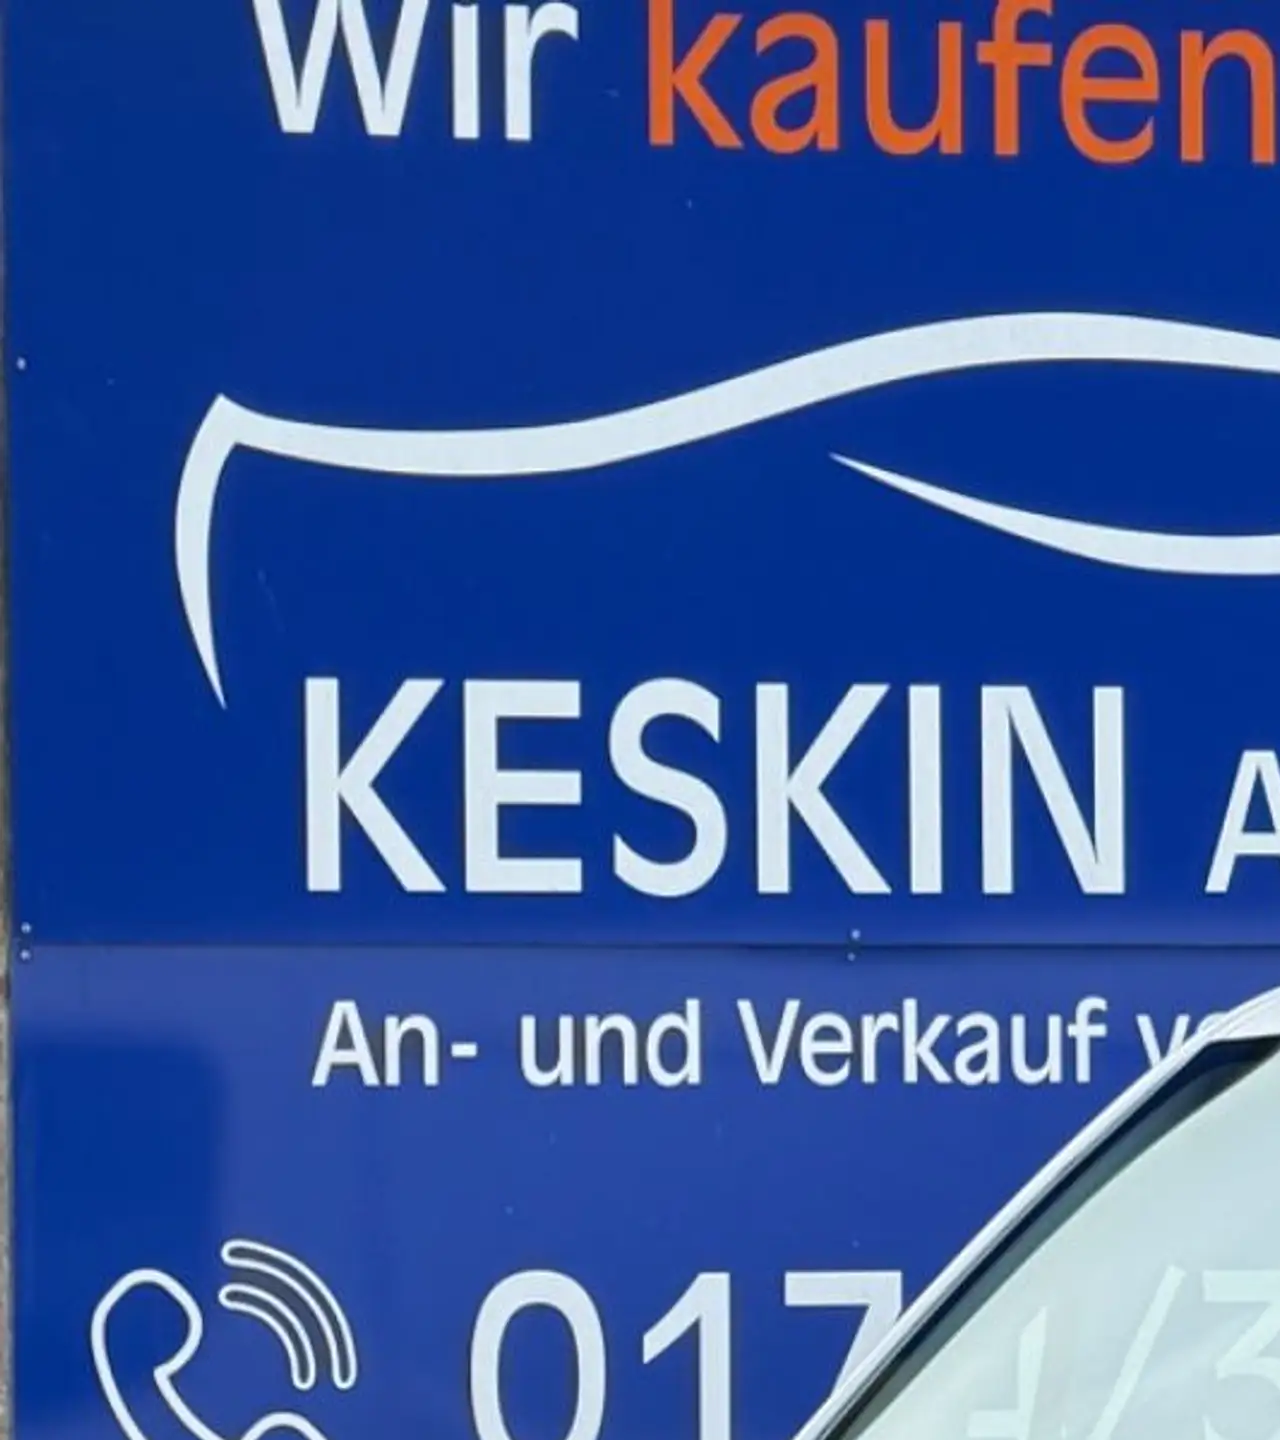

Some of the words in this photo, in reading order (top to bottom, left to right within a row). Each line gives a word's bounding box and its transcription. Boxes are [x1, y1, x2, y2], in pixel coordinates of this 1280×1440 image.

[254, 0, 577, 141] Wir
[648, 0, 1275, 163] kaufen
[305, 677, 1125, 897] KESKIN
[311, 1000, 477, 1086] An-
[520, 998, 701, 1086] und
[737, 996, 1108, 1086] Verkauf
